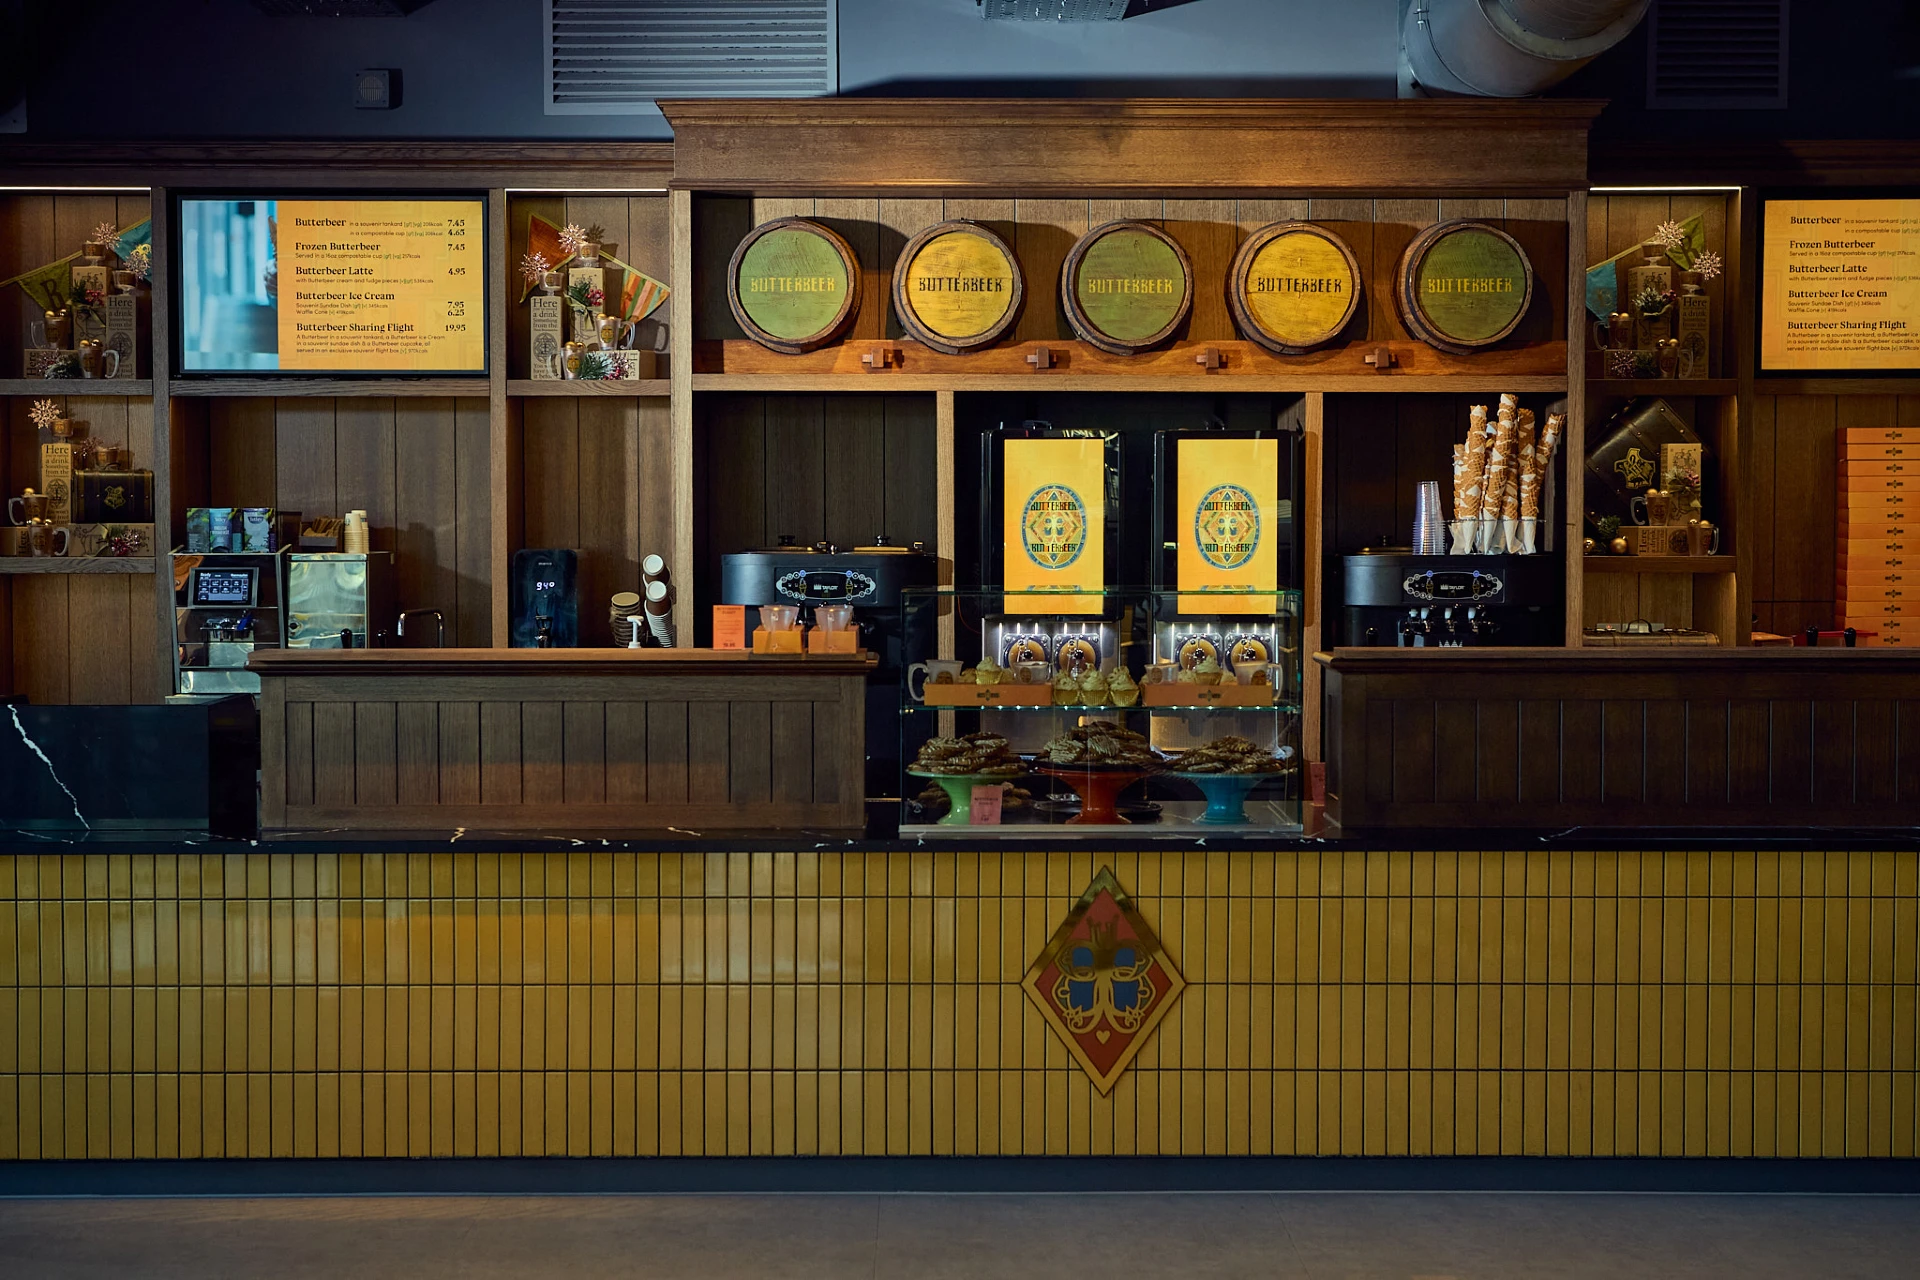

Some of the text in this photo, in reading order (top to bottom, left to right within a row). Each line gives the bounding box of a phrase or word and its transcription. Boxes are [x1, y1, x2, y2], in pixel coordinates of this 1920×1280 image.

[296, 218, 346, 226] Butterbeer
[1790, 216, 1842, 224] Butterbeer
[1790, 240, 1876, 248] Frozen Butterbeer
[296, 266, 346, 274] Butterbeer
[349, 266, 374, 274] Latte
[1790, 264, 1868, 272] Butterbeer Latte
[751, 278, 835, 292] BUTTERBEER
[919, 278, 1002, 292] BUTTERBEER
[1088, 278, 1173, 294] BUTTERBEER
[1258, 277, 1342, 293] BUTTERBEER
[1428, 278, 1512, 294] BUTTERBEER
[296, 292, 394, 300] Butterbeer Ice Cream
[1857, 290, 1888, 298] Cream
[108, 297, 132, 306] Here
[533, 298, 558, 308] Here
[1683, 297, 1706, 306] Here
[297, 323, 348, 331] Butterbeer
[350, 323, 386, 333] Sharing
[388, 323, 414, 333] Flight
[1788, 321, 1906, 331] Butterbeer Sharing Flight
[26, 352, 36, 376] Here
[628, 353, 638, 377] Here
[46, 445, 69, 454] Here
[1030, 502, 1078, 510] BUTTERBEER
[1204, 502, 1252, 510] BUTTERBEER
